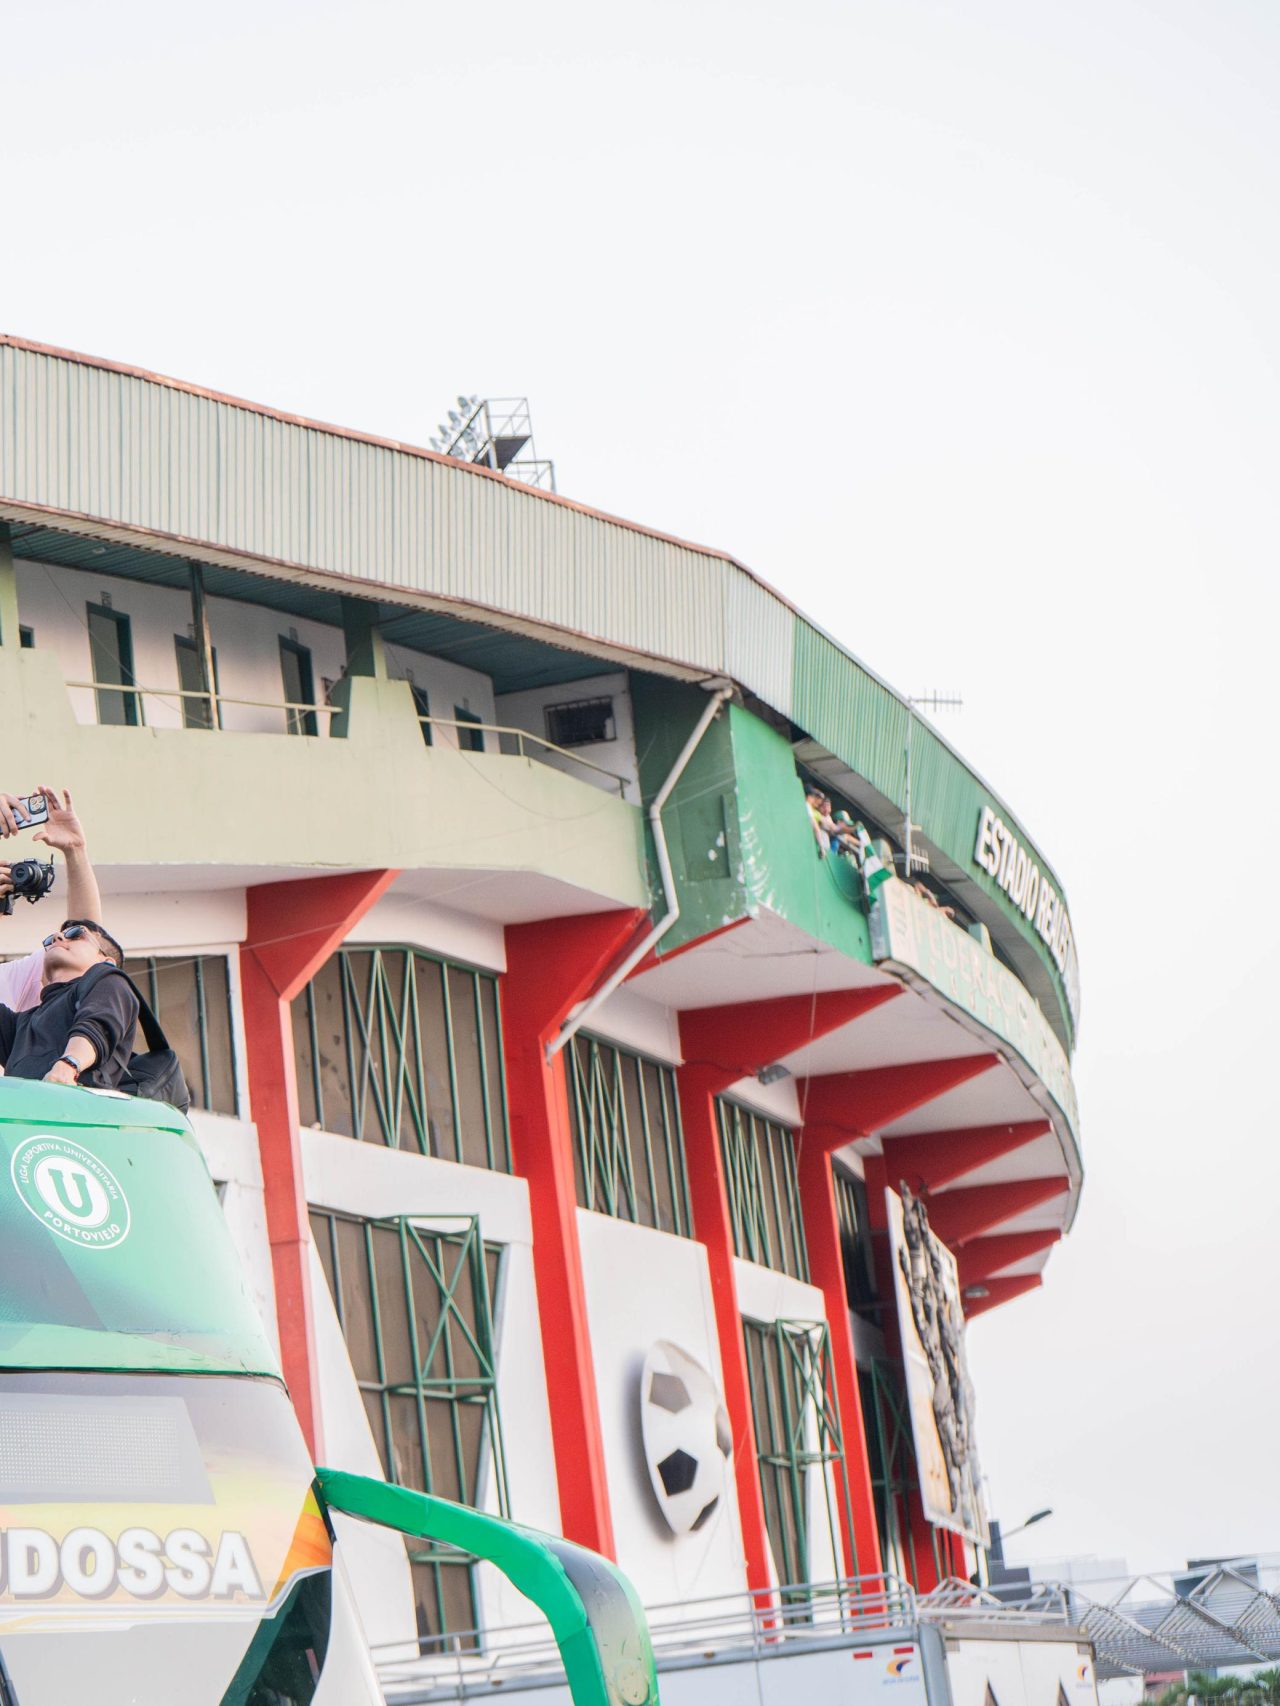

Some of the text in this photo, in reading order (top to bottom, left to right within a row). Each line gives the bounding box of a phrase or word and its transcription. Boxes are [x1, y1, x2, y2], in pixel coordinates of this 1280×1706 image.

[973, 804, 1041, 922] ESTADIO
[22, 1142, 62, 1164] DEPORTIVA
[63, 1145, 119, 1201] UNIVERSITARIA
[47, 1167, 95, 1218] U
[43, 1210, 121, 1242] PORTOVIEJO
